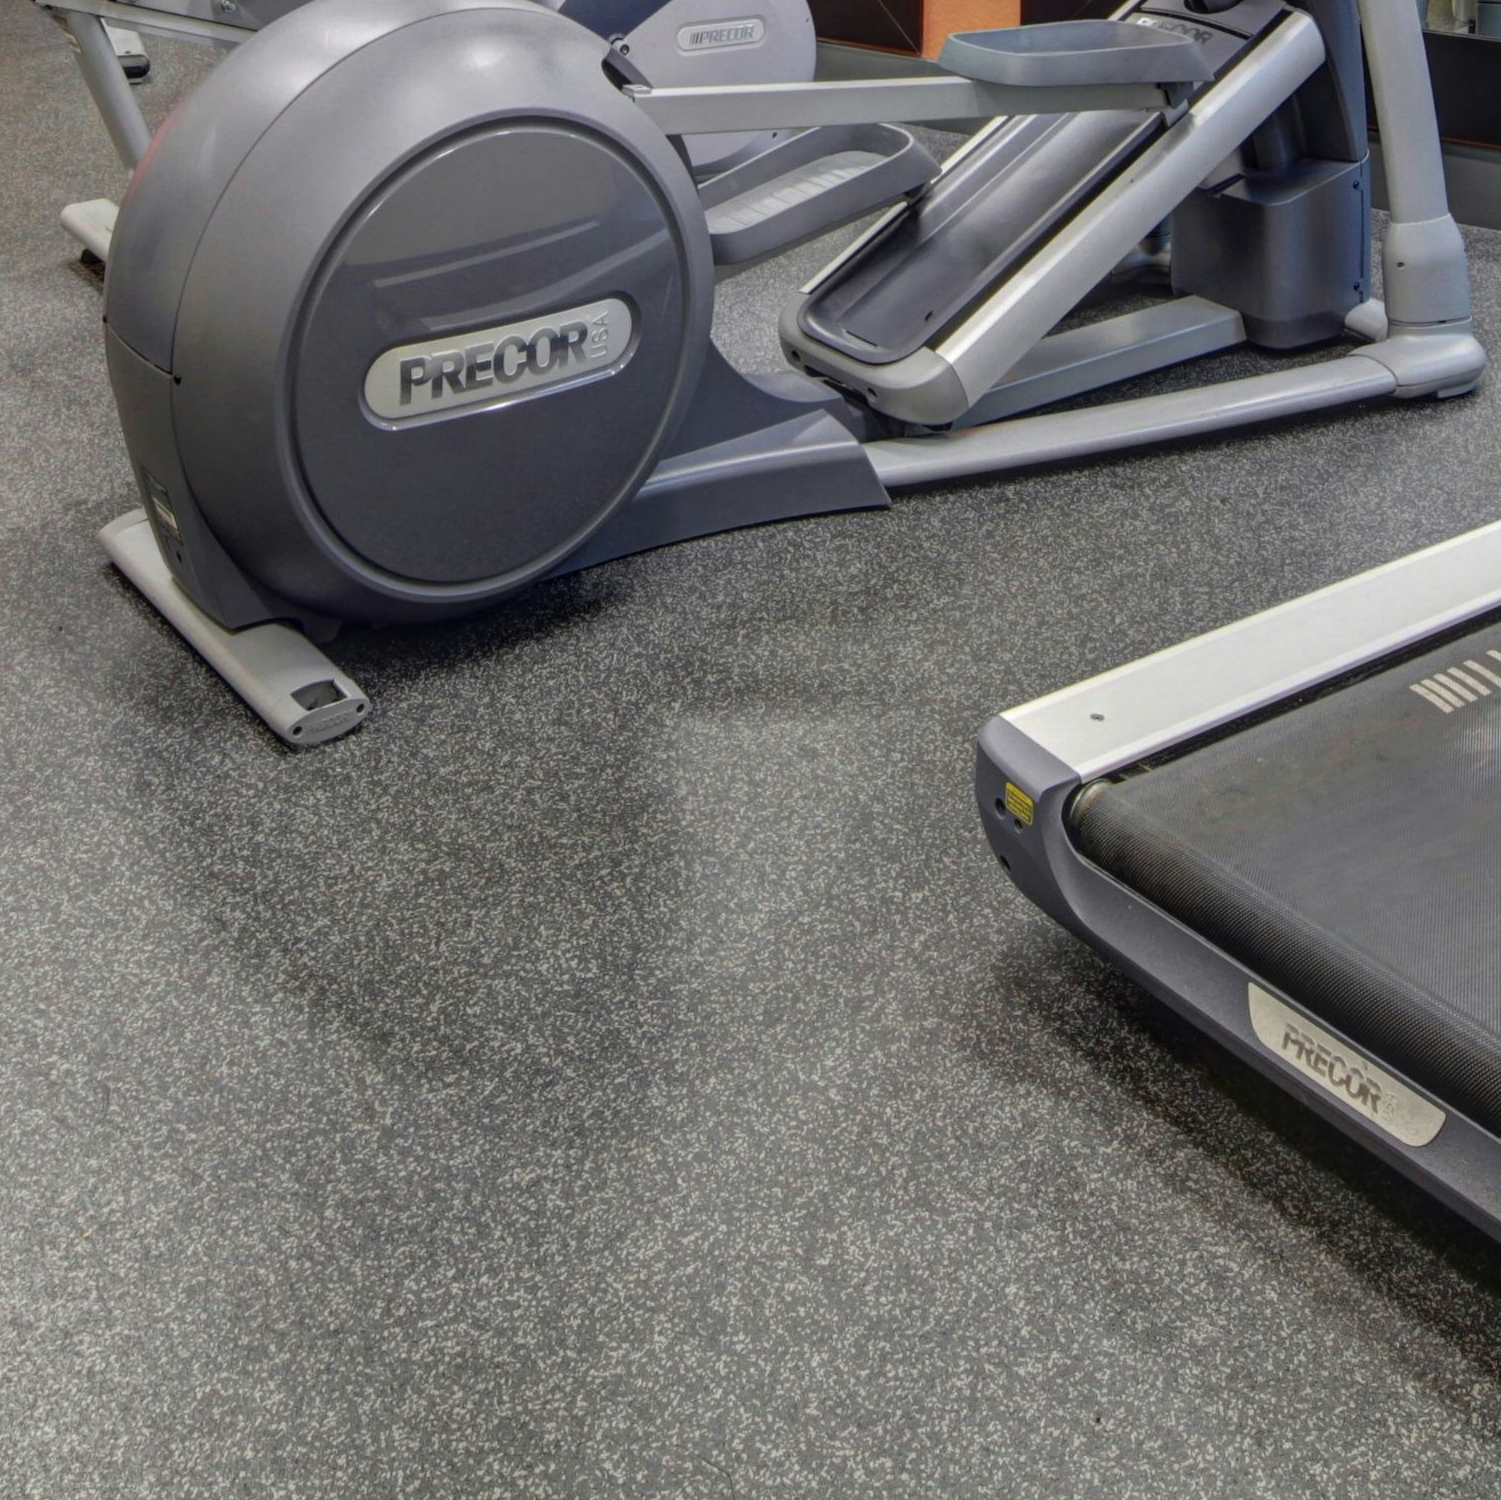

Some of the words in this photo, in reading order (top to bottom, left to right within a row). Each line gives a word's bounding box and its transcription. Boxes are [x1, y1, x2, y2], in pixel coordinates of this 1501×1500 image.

[699, 26, 755, 45] PRECOR
[399, 320, 590, 406] PRECOR
[589, 310, 609, 360] USA
[1281, 1022, 1383, 1114] PRECOR
